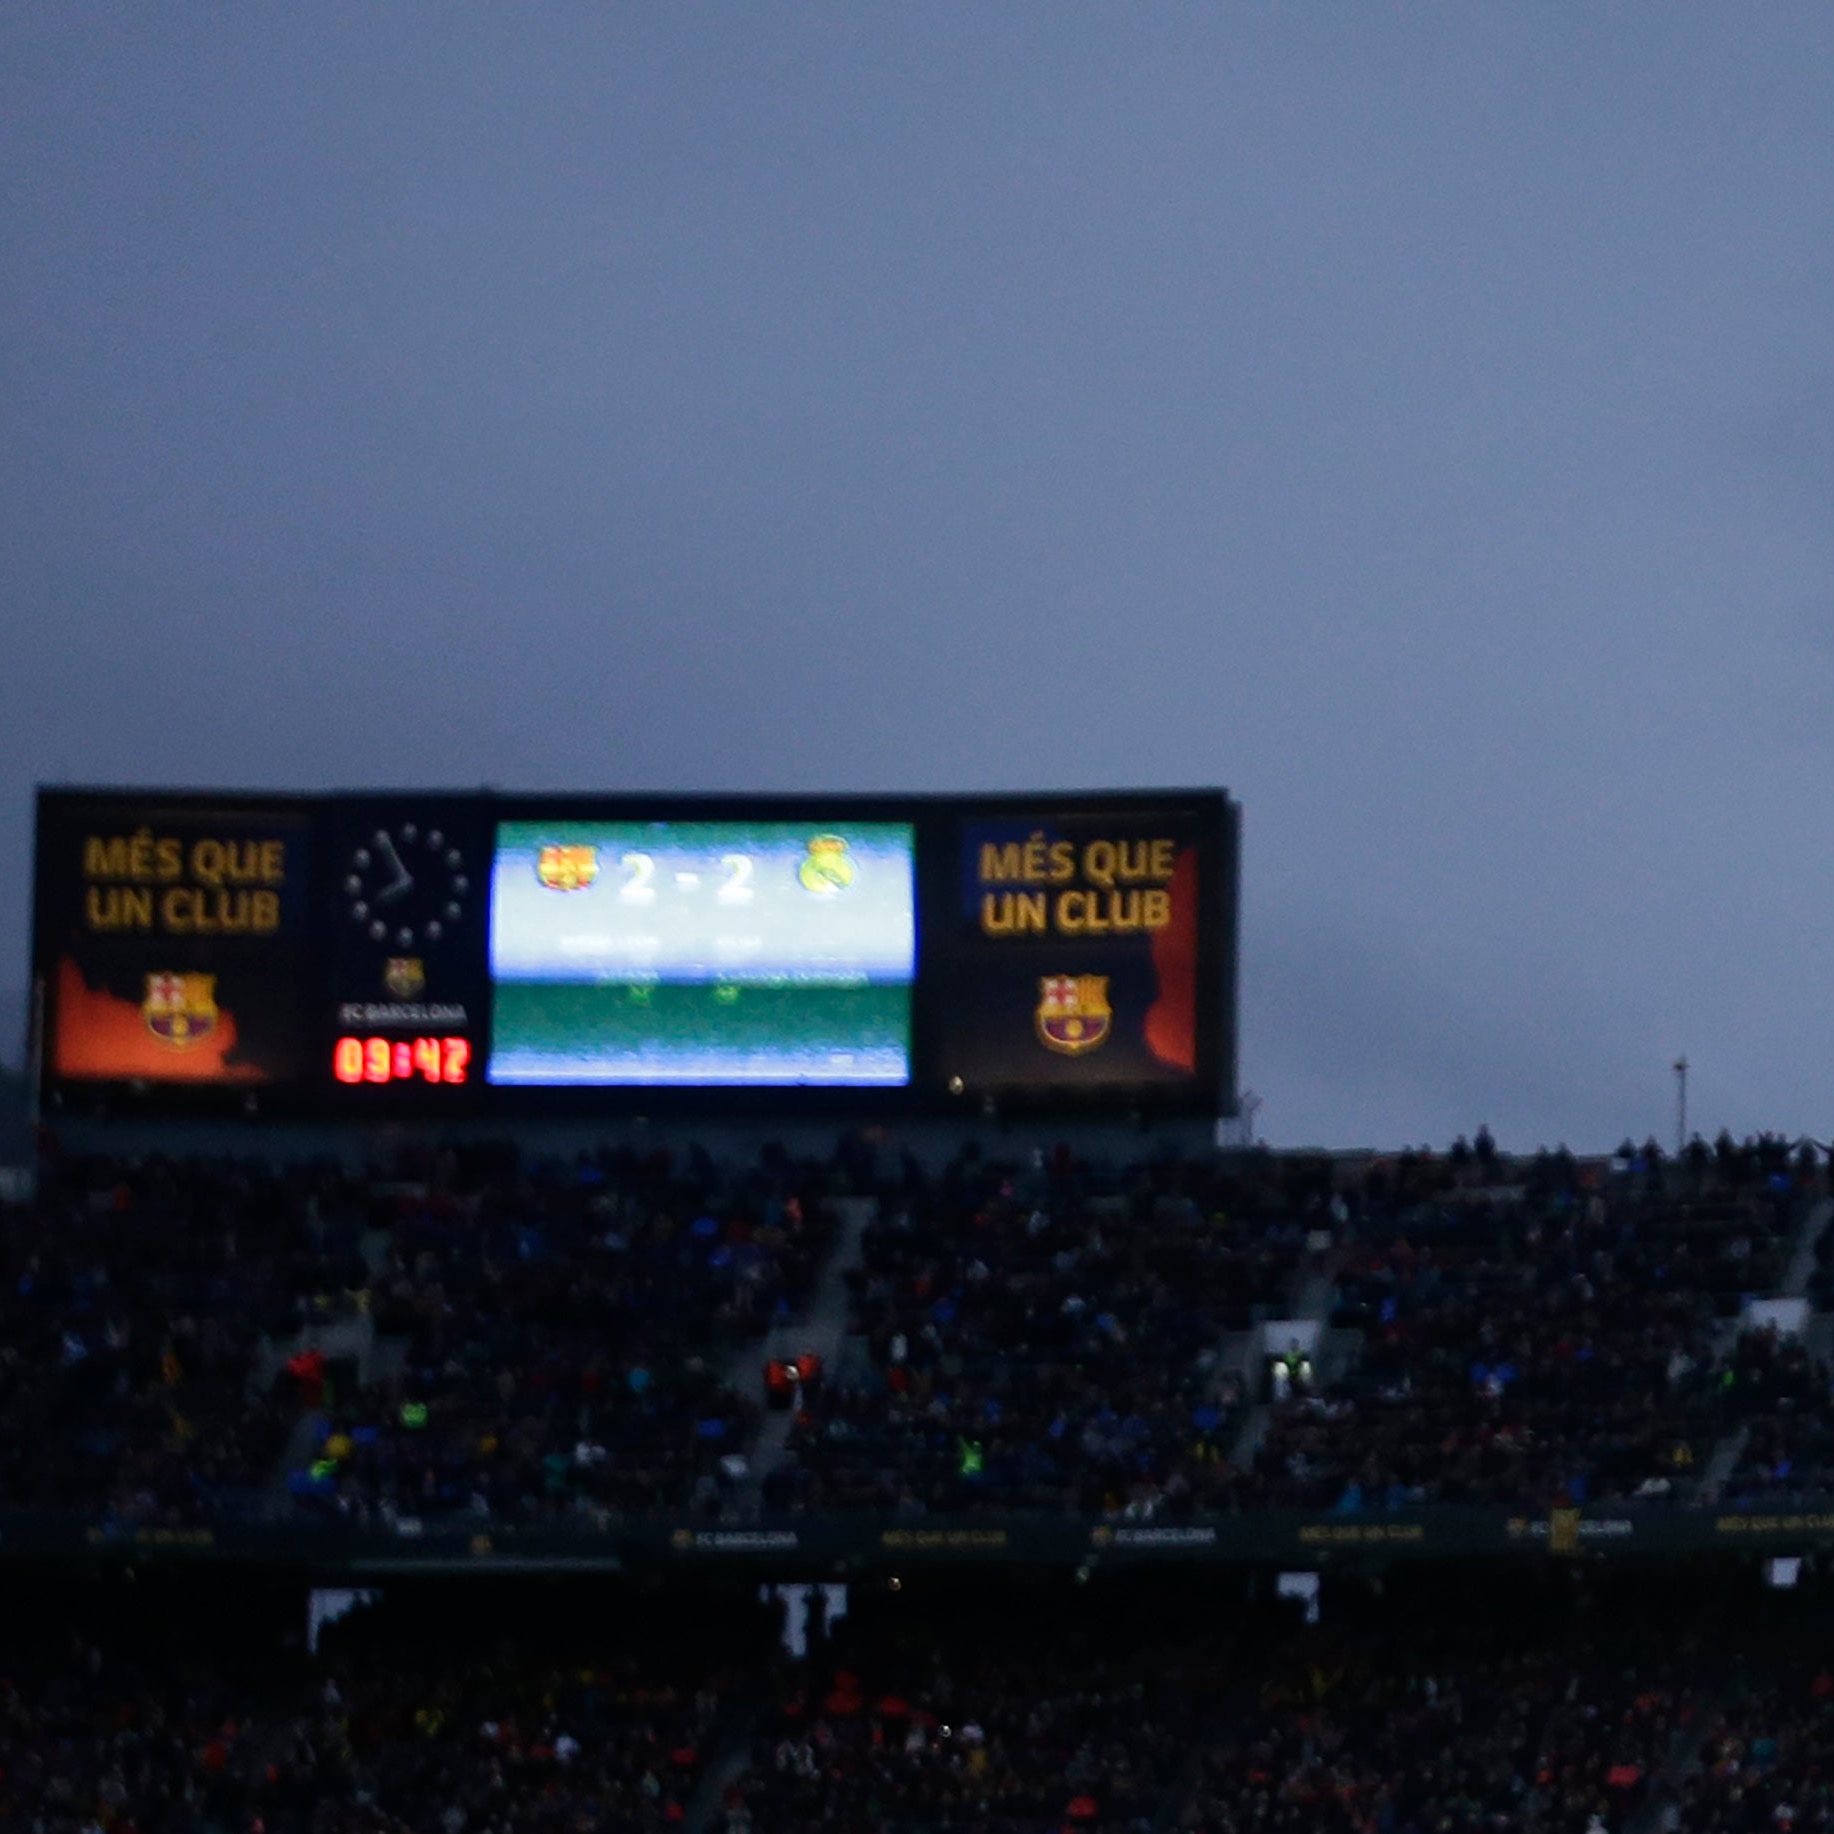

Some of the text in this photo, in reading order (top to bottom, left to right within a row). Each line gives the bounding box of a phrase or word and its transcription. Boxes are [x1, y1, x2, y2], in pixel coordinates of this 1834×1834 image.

[83, 825, 285, 888] MÉS QUE
[619, 854, 655, 903] 2
[717, 854, 753, 903] 2
[980, 830, 1175, 888] MÉS QUE
[86, 885, 280, 935] UN CLUB
[982, 890, 1171, 935] UN CLUB
